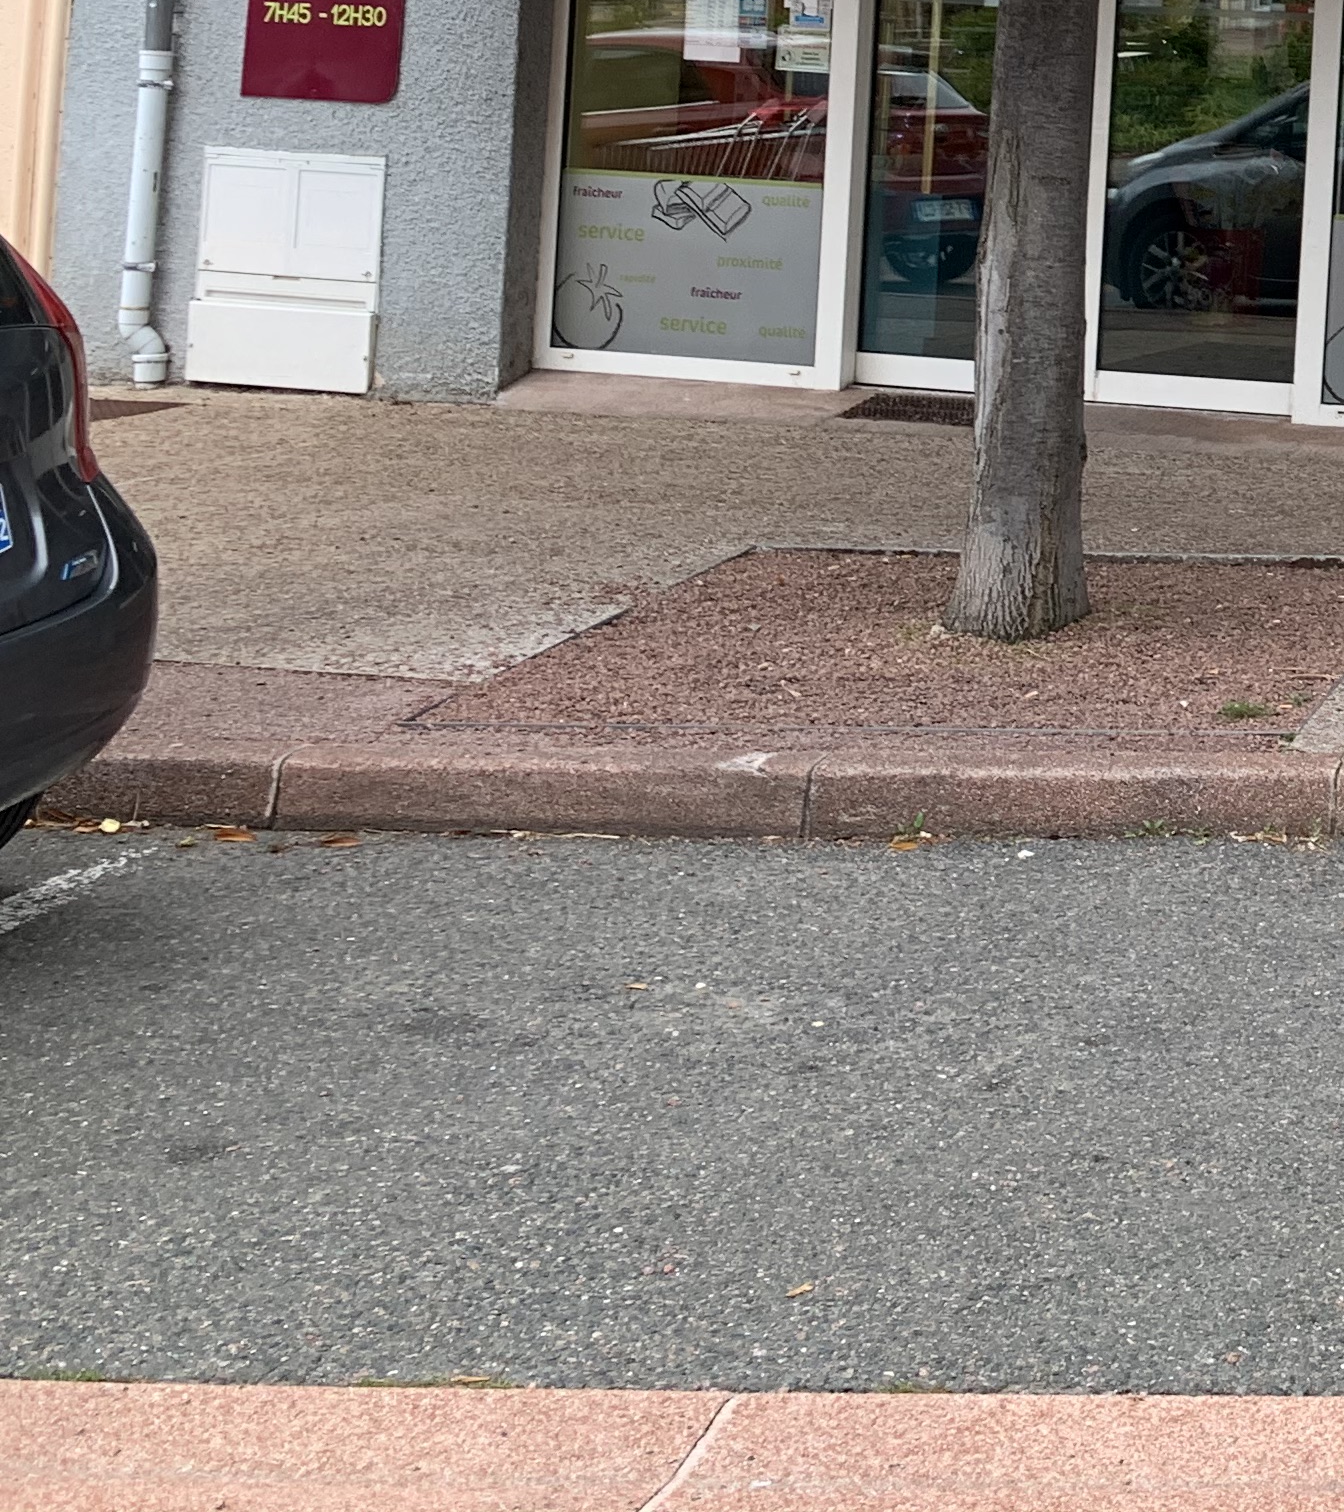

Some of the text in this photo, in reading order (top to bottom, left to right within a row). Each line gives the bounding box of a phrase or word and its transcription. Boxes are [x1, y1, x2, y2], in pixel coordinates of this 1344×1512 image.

[263, 1, 311, 24] 7H45
[573, 186, 623, 200] fraîcheur
[578, 223, 645, 242] service
[716, 255, 783, 271] proximité
[690, 287, 742, 301] fraîcheur
[659, 316, 727, 335] service
